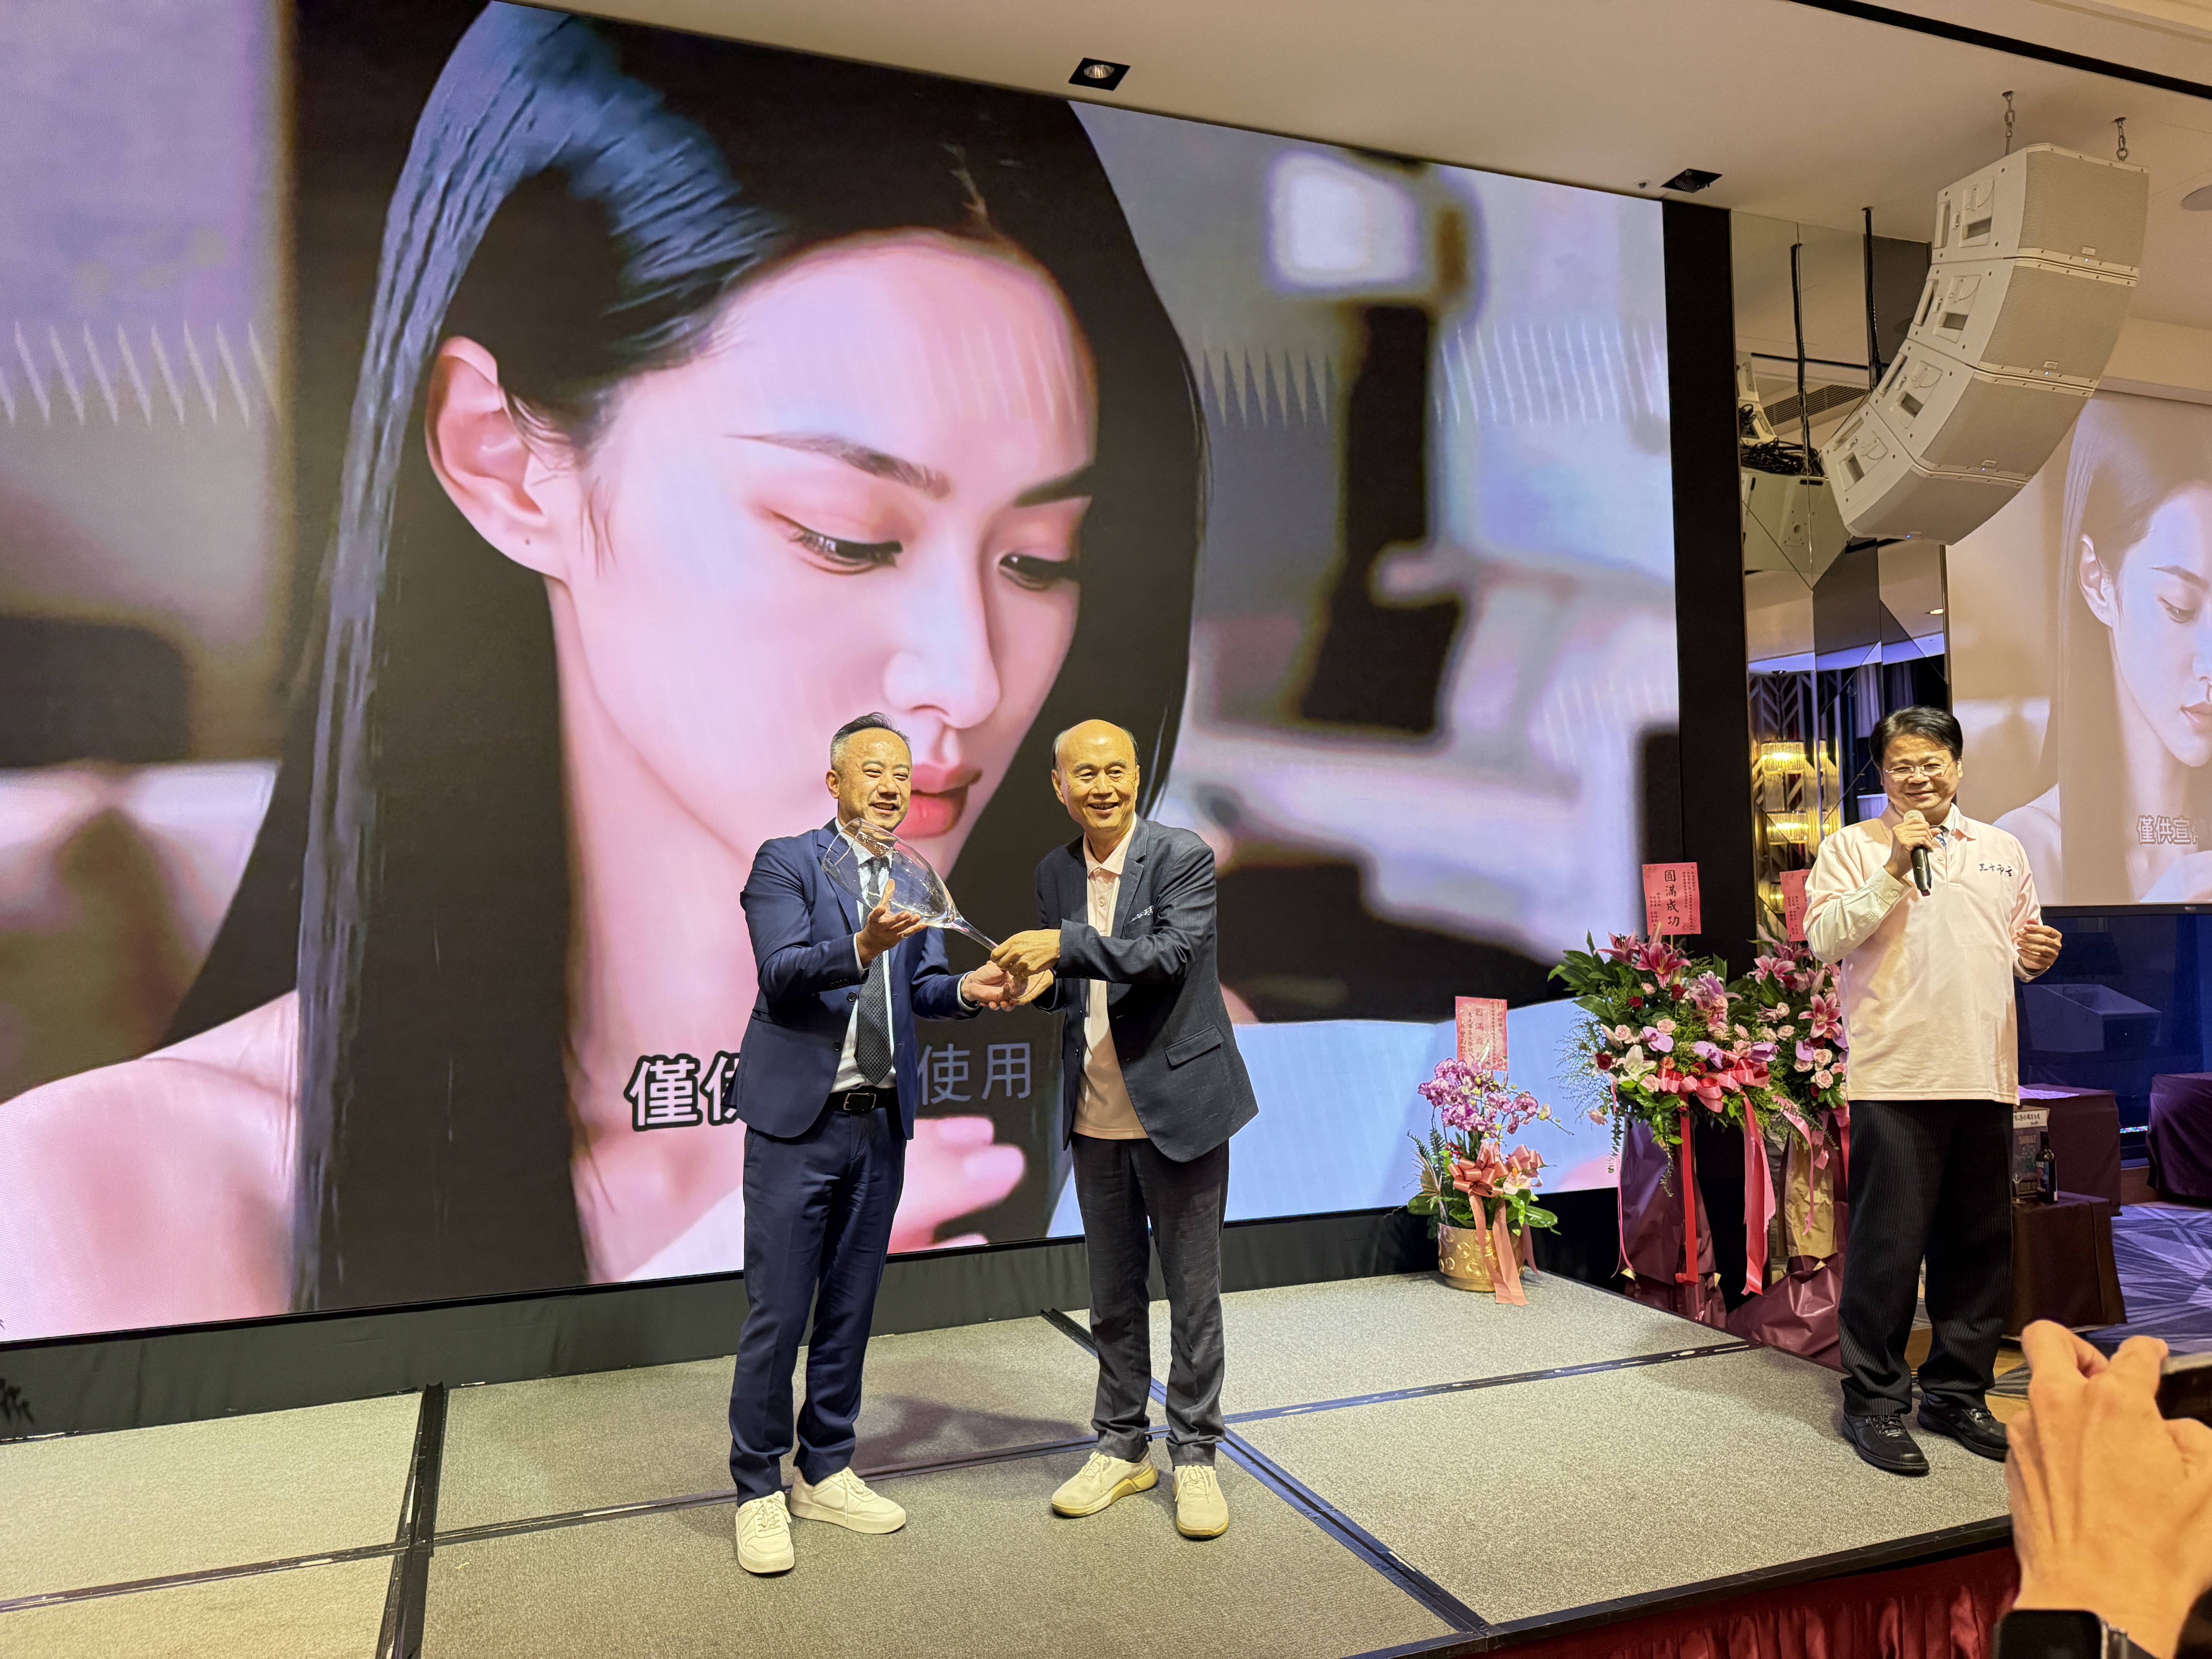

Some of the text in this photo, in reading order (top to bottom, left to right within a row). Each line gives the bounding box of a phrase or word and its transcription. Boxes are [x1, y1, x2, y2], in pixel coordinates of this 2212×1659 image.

[2136, 815, 2198, 845] 僅供宣
[1665, 869, 1680, 927] 圓滿成功
[917, 1042, 1030, 1106] 使用
